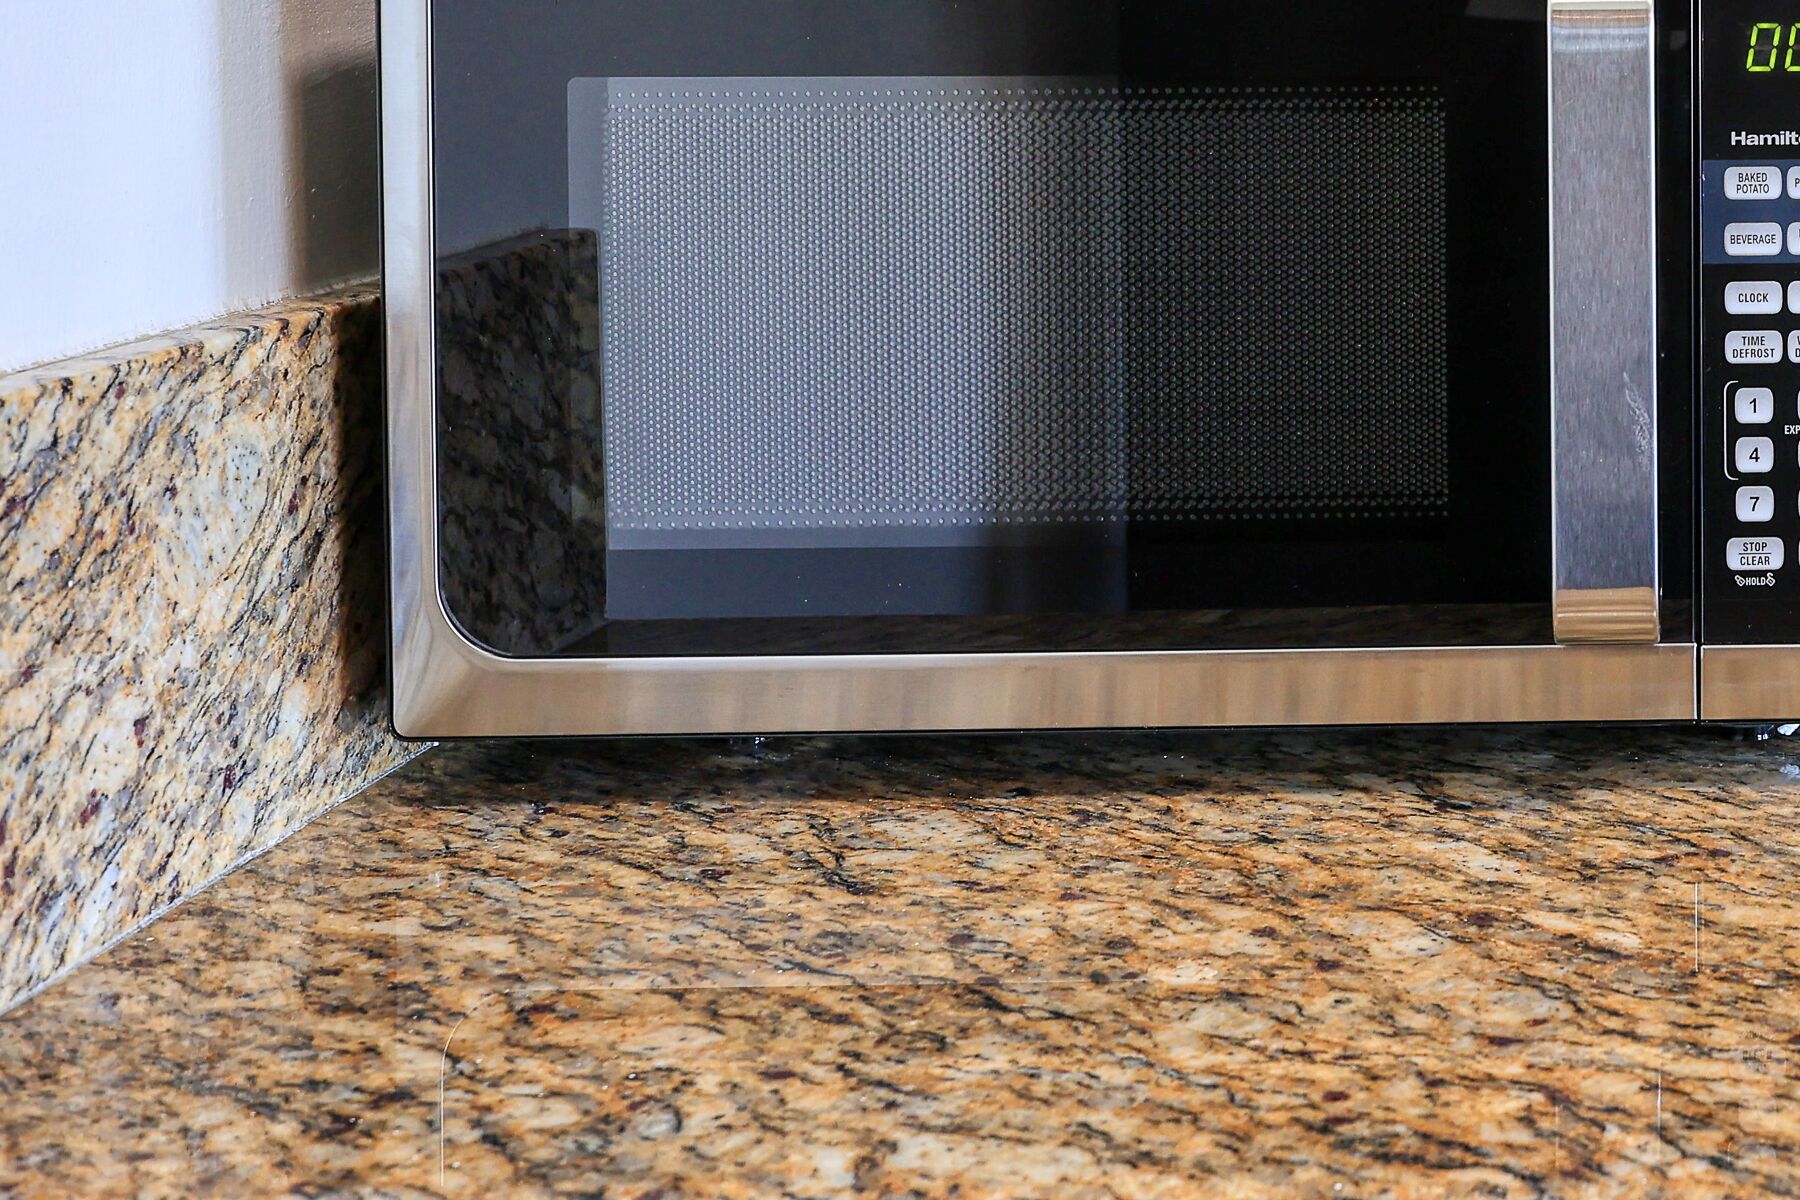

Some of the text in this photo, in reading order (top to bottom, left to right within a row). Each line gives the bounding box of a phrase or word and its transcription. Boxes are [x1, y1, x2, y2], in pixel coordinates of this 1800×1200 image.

[1738, 172, 1767, 183] BAKED
[1736, 183, 1769, 194] POTATO
[1730, 233, 1776, 245] BEVERAGE
[1738, 293, 1769, 303] CLOCK
[1741, 336, 1766, 346] TIME
[1732, 348, 1775, 359] DEFROST
[1749, 398, 1758, 413] 1
[1749, 448, 1760, 462] 4
[1749, 497, 1760, 511] 7
[1742, 542, 1767, 552] STOP
[1739, 556, 1770, 566] CLEAR
[1745, 576, 1766, 586] HOLD
